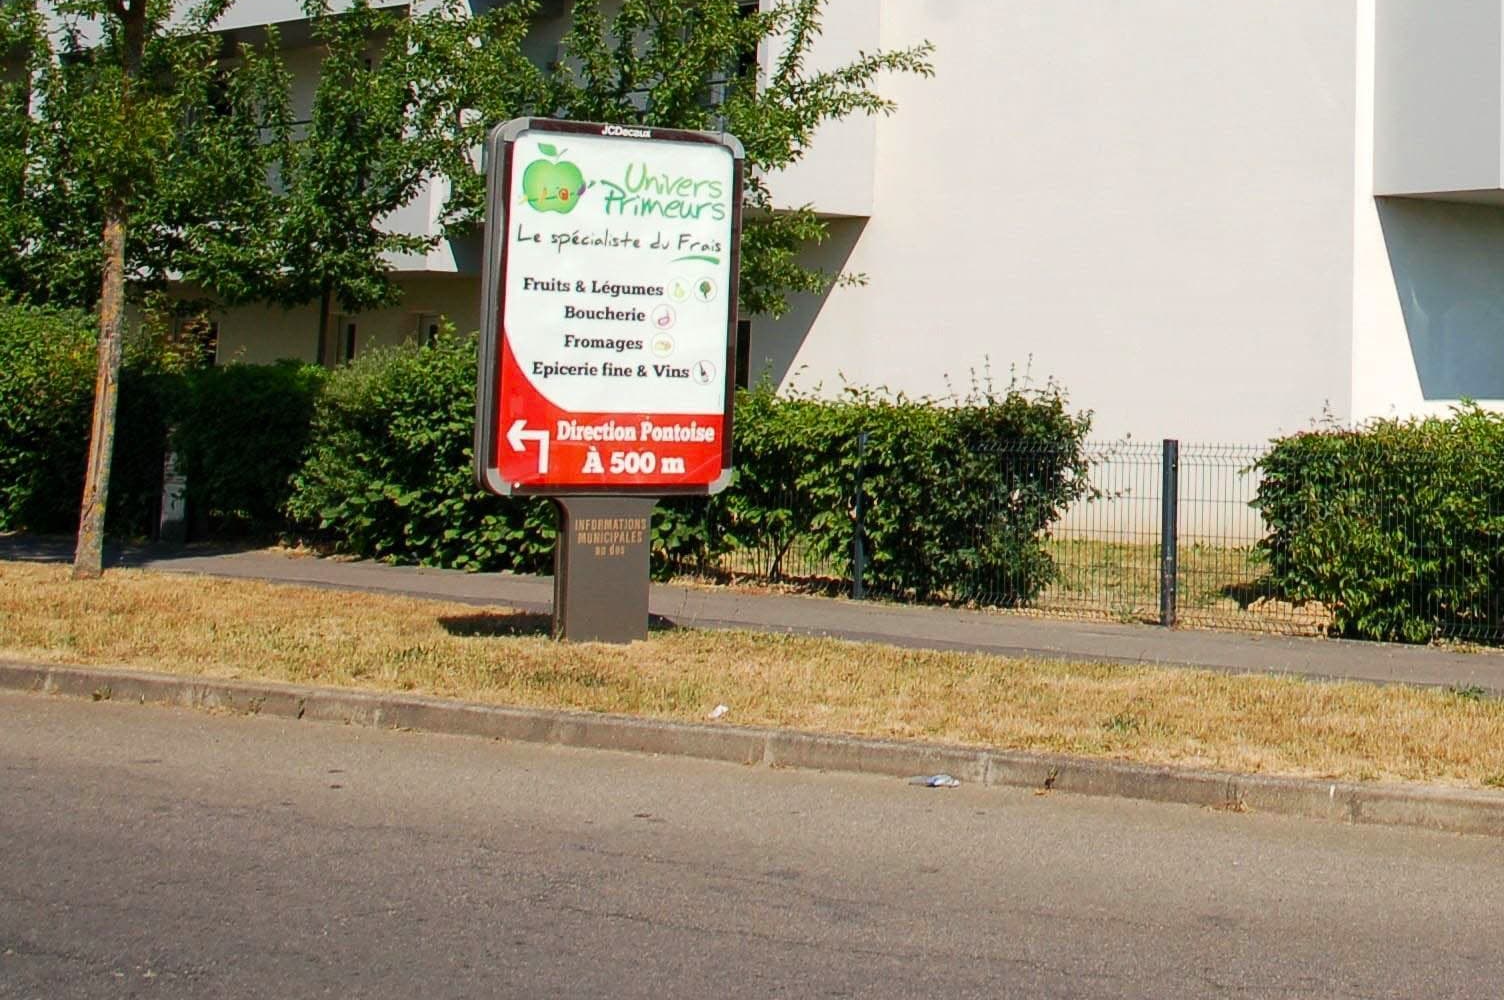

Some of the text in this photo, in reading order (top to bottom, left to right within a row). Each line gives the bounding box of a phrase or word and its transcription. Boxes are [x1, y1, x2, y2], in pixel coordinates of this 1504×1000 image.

[601, 125, 651, 138] JCDecaux
[624, 162, 723, 198] Univers
[600, 179, 725, 221] Primeurs
[517, 223, 721, 253] Le spécialiste du Frais
[523, 277, 664, 298] Fruits & Légumes
[564, 305, 646, 322] Boucherie
[564, 334, 643, 353] Fromages
[532, 361, 690, 378] Epicerie fine & Vins
[557, 419, 715, 442] Direction Pontoise
[581, 445, 686, 474] À 500 m
[575, 518, 647, 531] INFORMATIONS
[577, 531, 643, 544] MUNICIPALES
